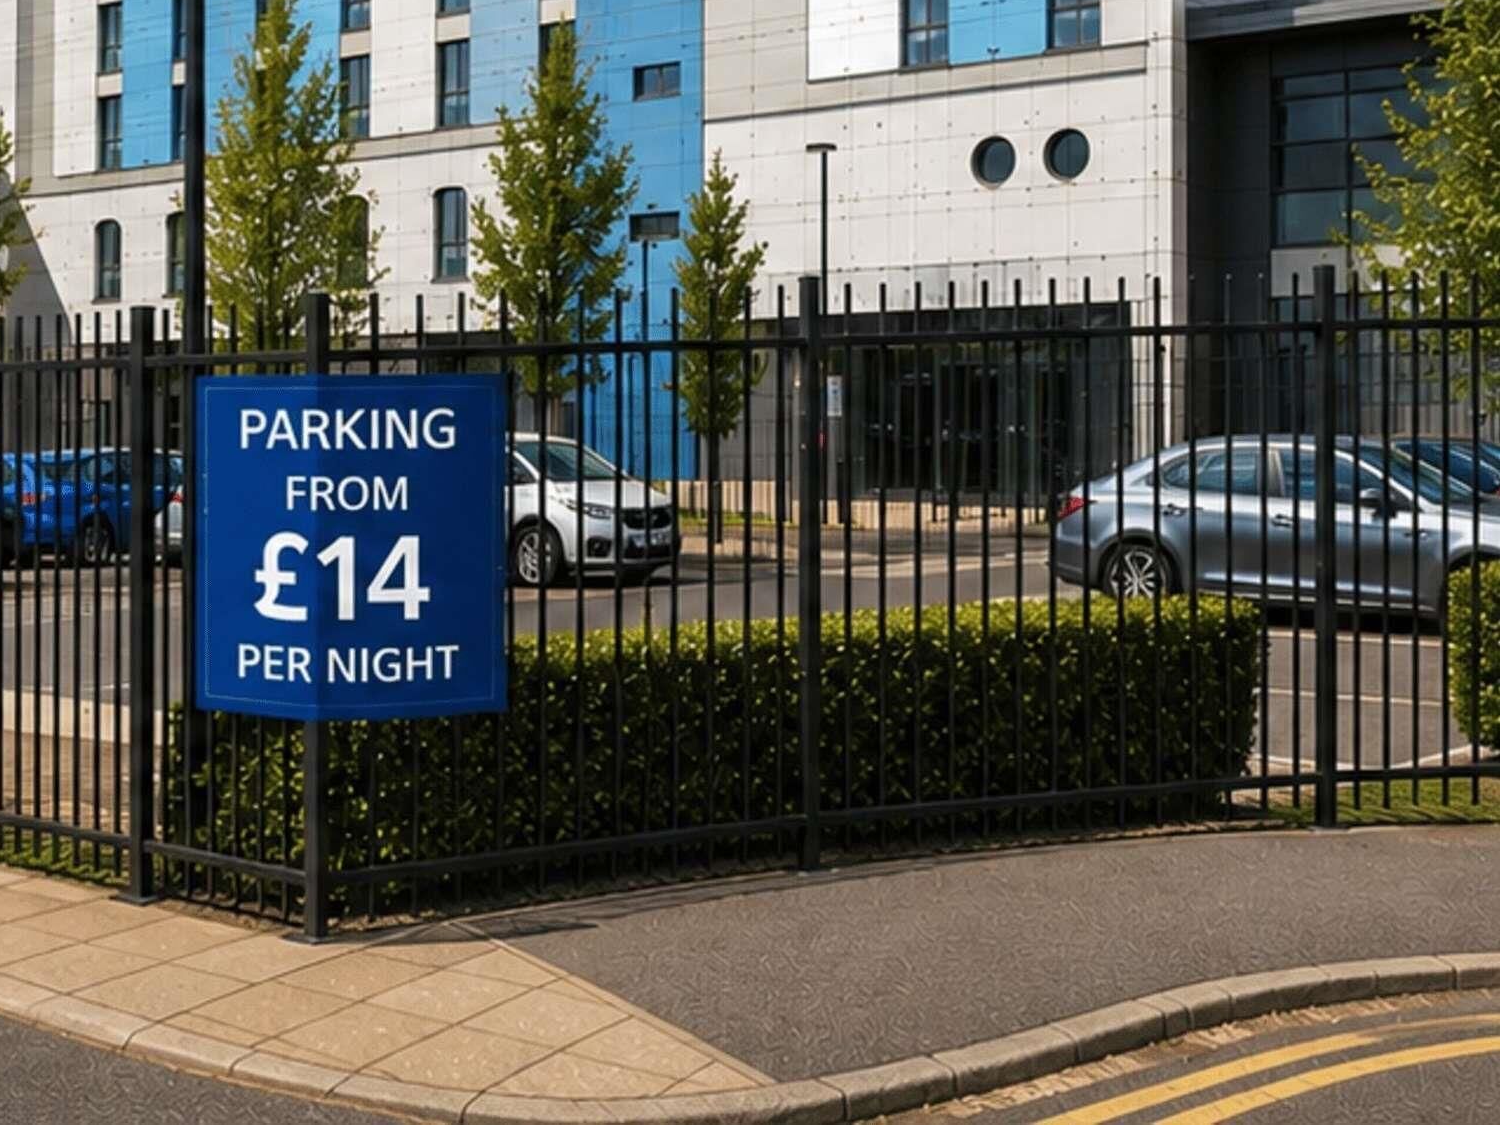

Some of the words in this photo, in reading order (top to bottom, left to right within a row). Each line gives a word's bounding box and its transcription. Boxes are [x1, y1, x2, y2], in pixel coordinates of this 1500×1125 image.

[240, 408, 456, 451] PARKING
[285, 475, 408, 512] FROM
[253, 531, 431, 622] £14
[237, 643, 312, 683] PER
[327, 644, 460, 683] NIGHT
